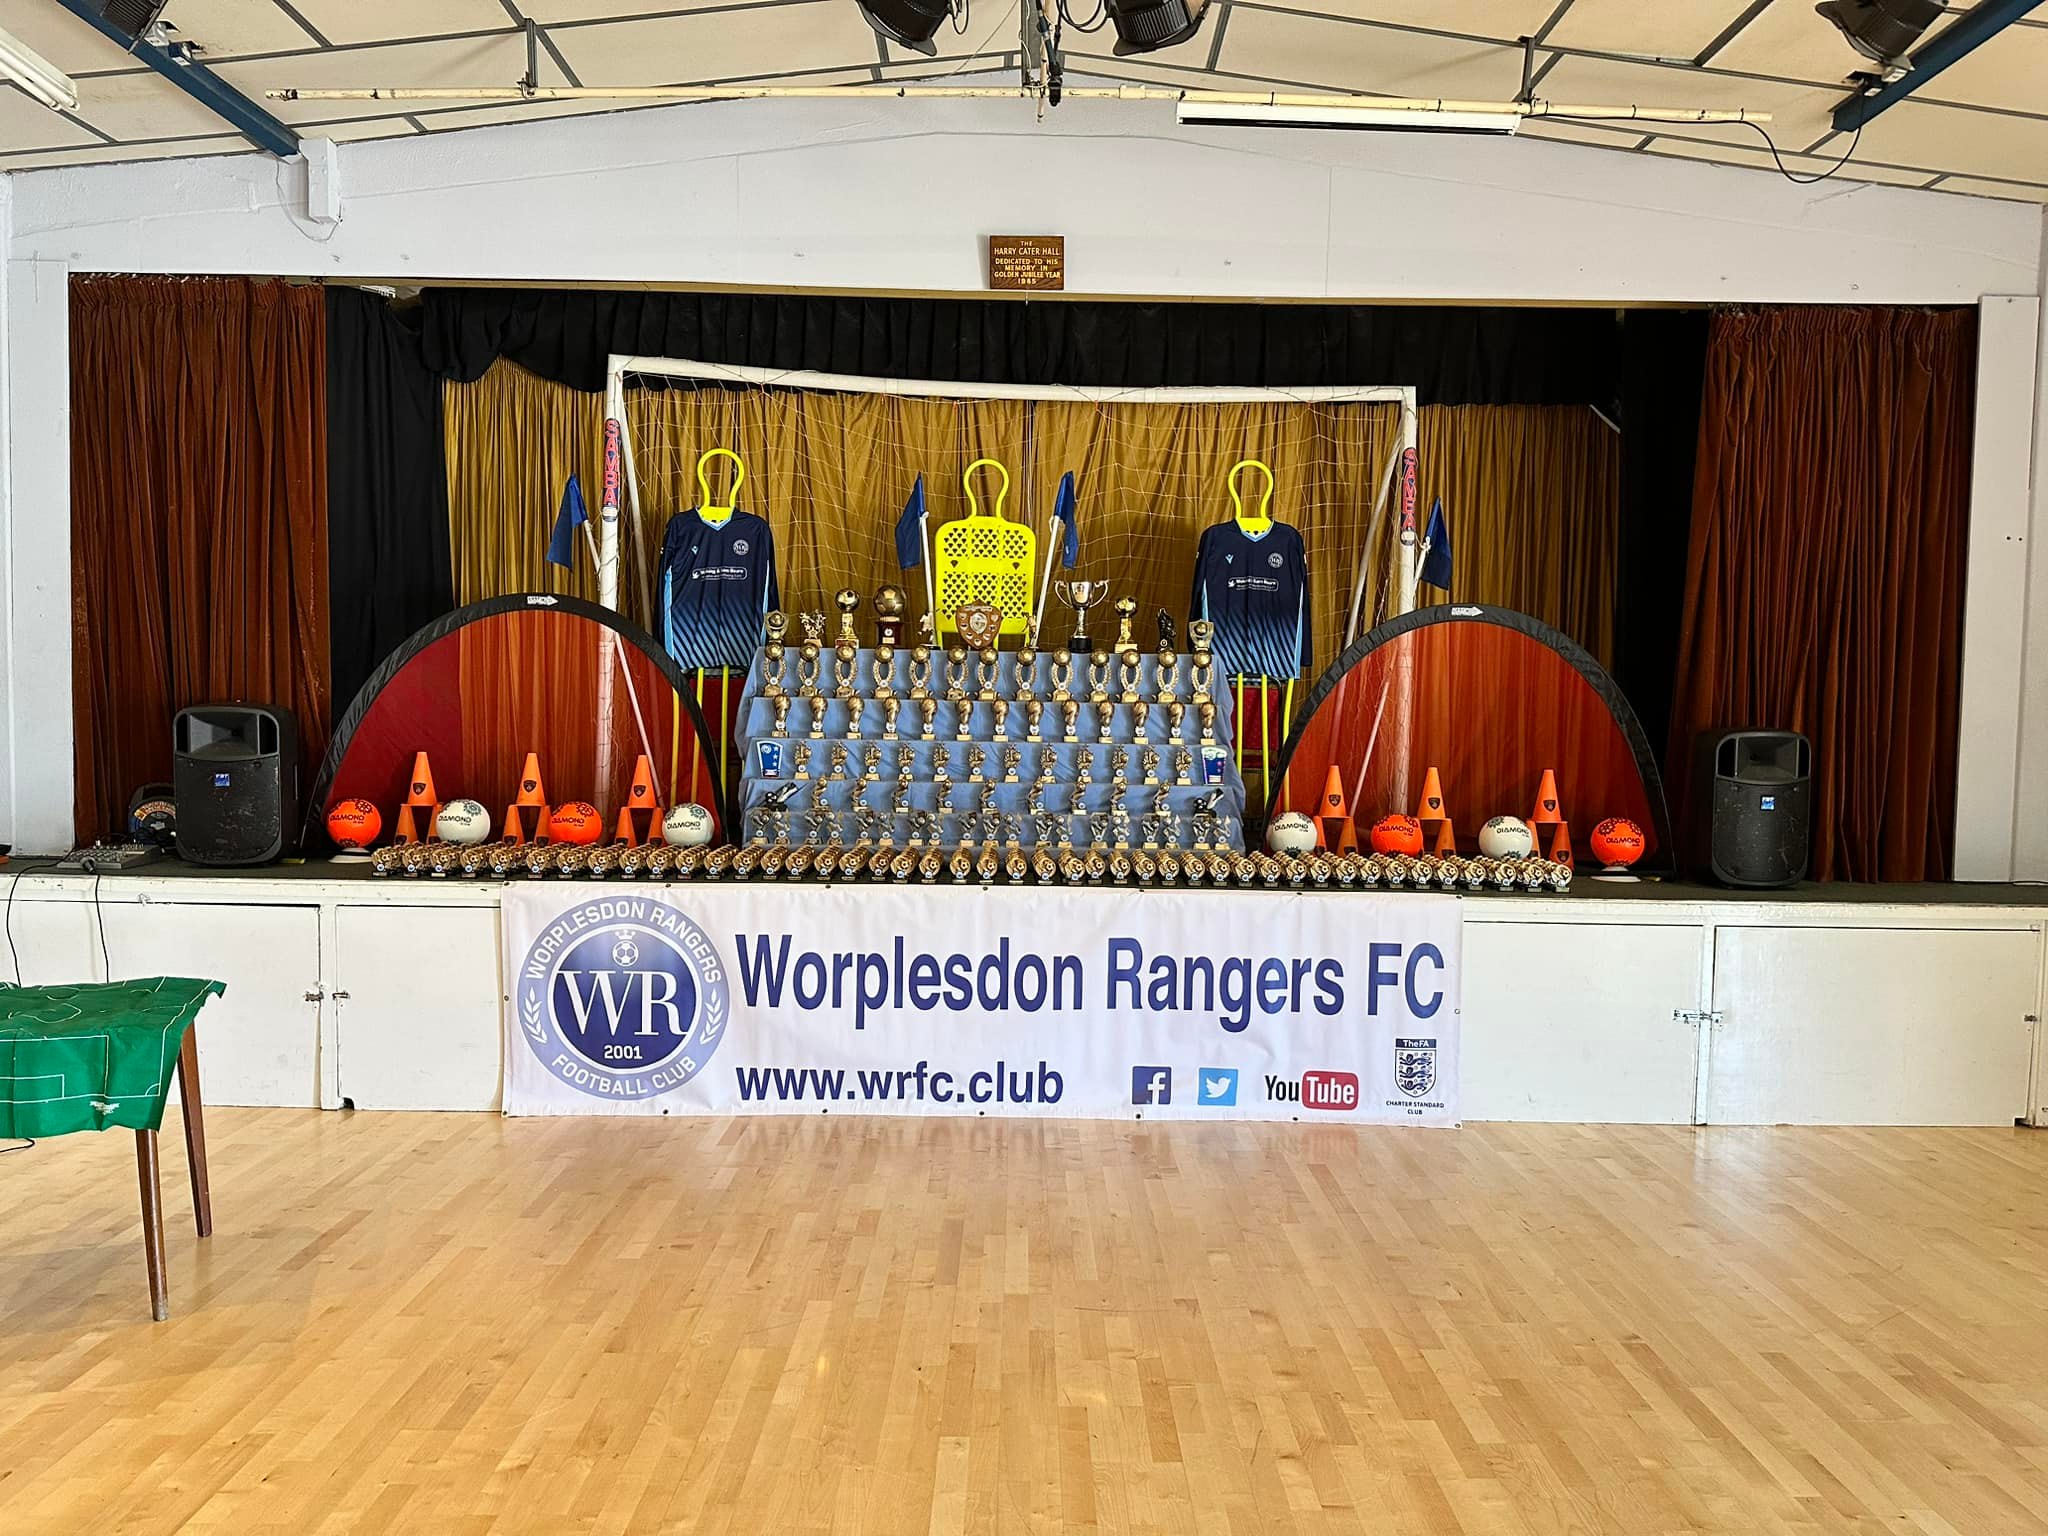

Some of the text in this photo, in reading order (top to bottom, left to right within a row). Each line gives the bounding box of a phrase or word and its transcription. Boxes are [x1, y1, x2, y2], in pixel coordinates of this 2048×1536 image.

[667, 821, 701, 830] DIAMOND
[1274, 823, 1309, 831] DIAMOND
[526, 900, 721, 984] WORPLESDON RANGERS
[558, 971, 688, 1036] WR
[735, 934, 1445, 1033] Worplesdon Rangers FC
[604, 1045, 643, 1059] 2001
[552, 1053, 696, 1095] FOOTBALL CLUB
[736, 1060, 1064, 1103] www.wrfc.club
